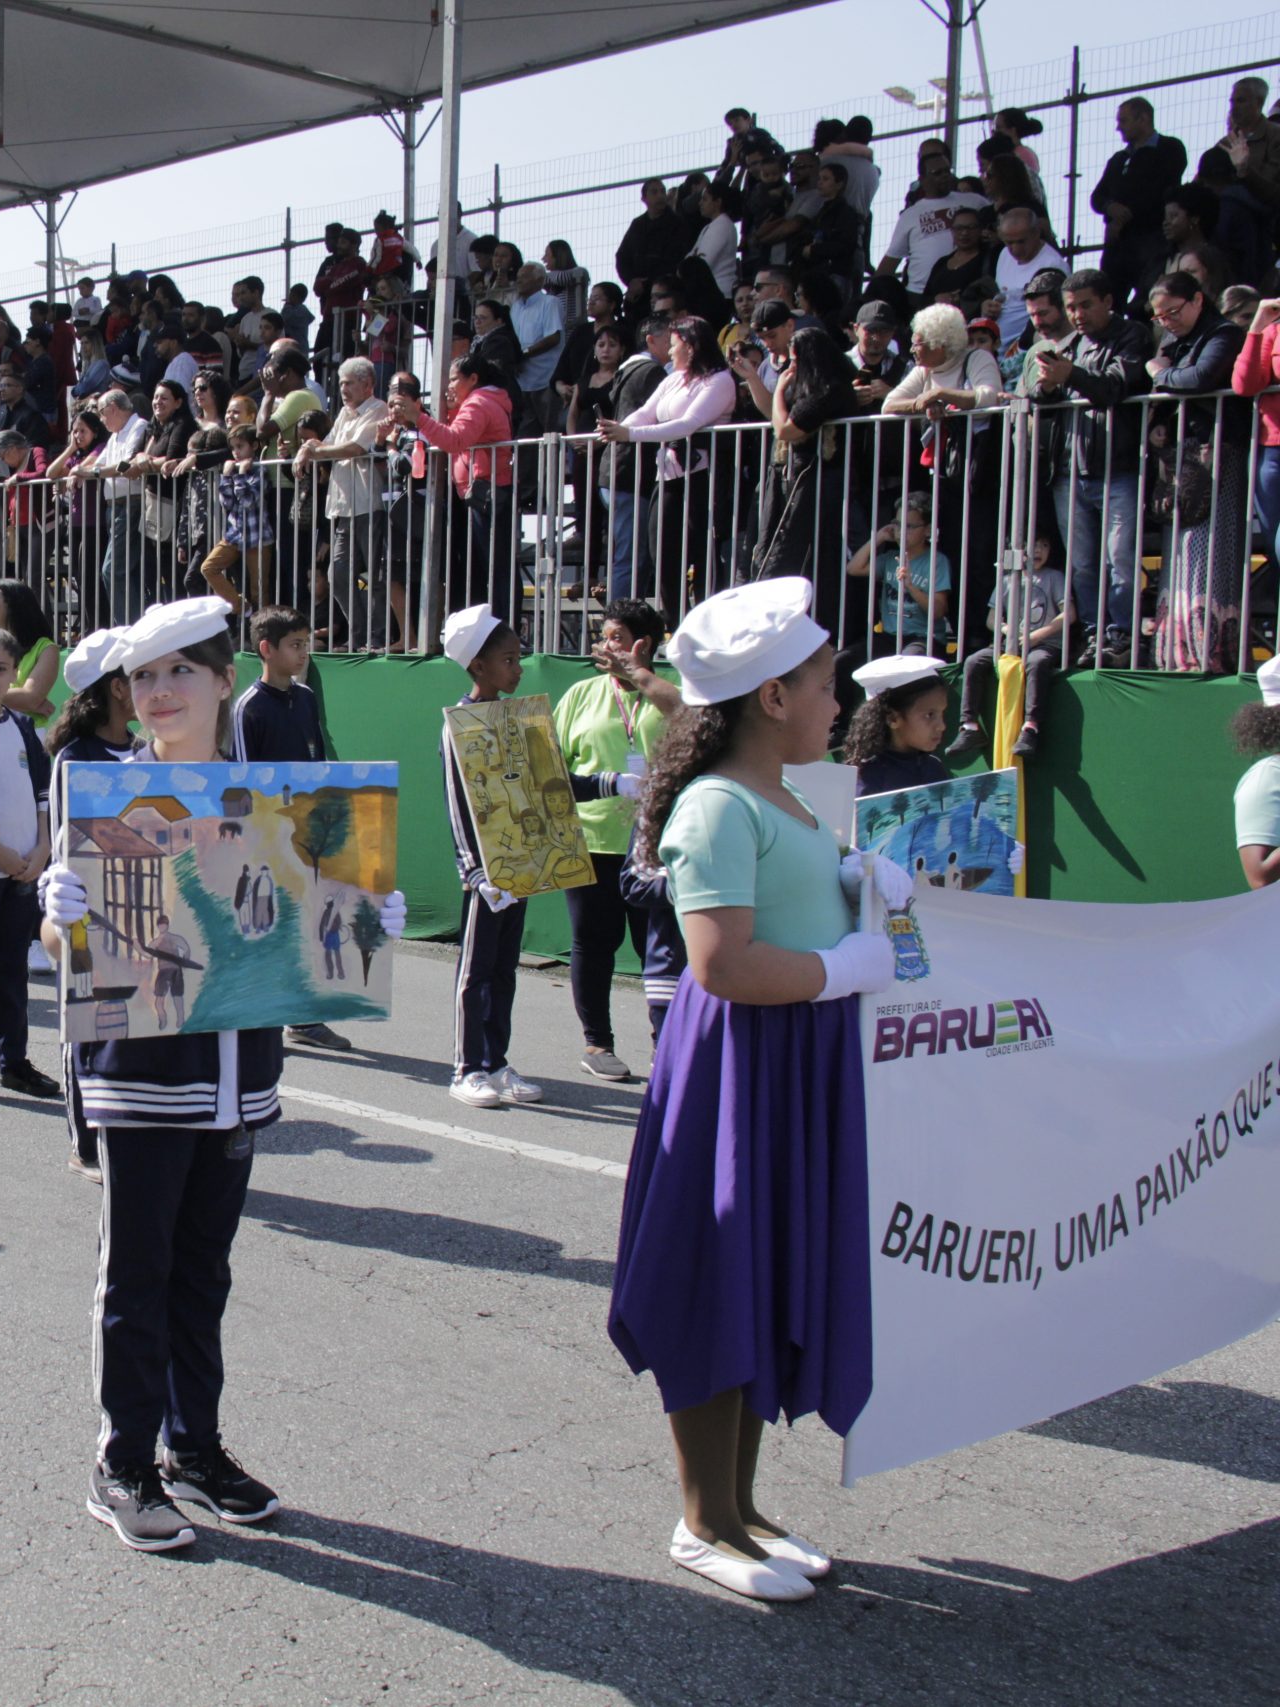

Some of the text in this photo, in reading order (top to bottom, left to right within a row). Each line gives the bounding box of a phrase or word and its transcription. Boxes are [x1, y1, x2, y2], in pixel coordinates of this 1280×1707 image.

[876, 1000, 942, 1016] PREFEITURA DE
[873, 997, 1053, 1063] BARUERI
[985, 1037, 1055, 1058] CIDADE INTELIGENTE
[880, 1201, 1042, 1290] BARUERI,
[1054, 1193, 1129, 1272] UMA
[1135, 1110, 1230, 1226] PAIXÃO
[1233, 1061, 1273, 1137] QUE
